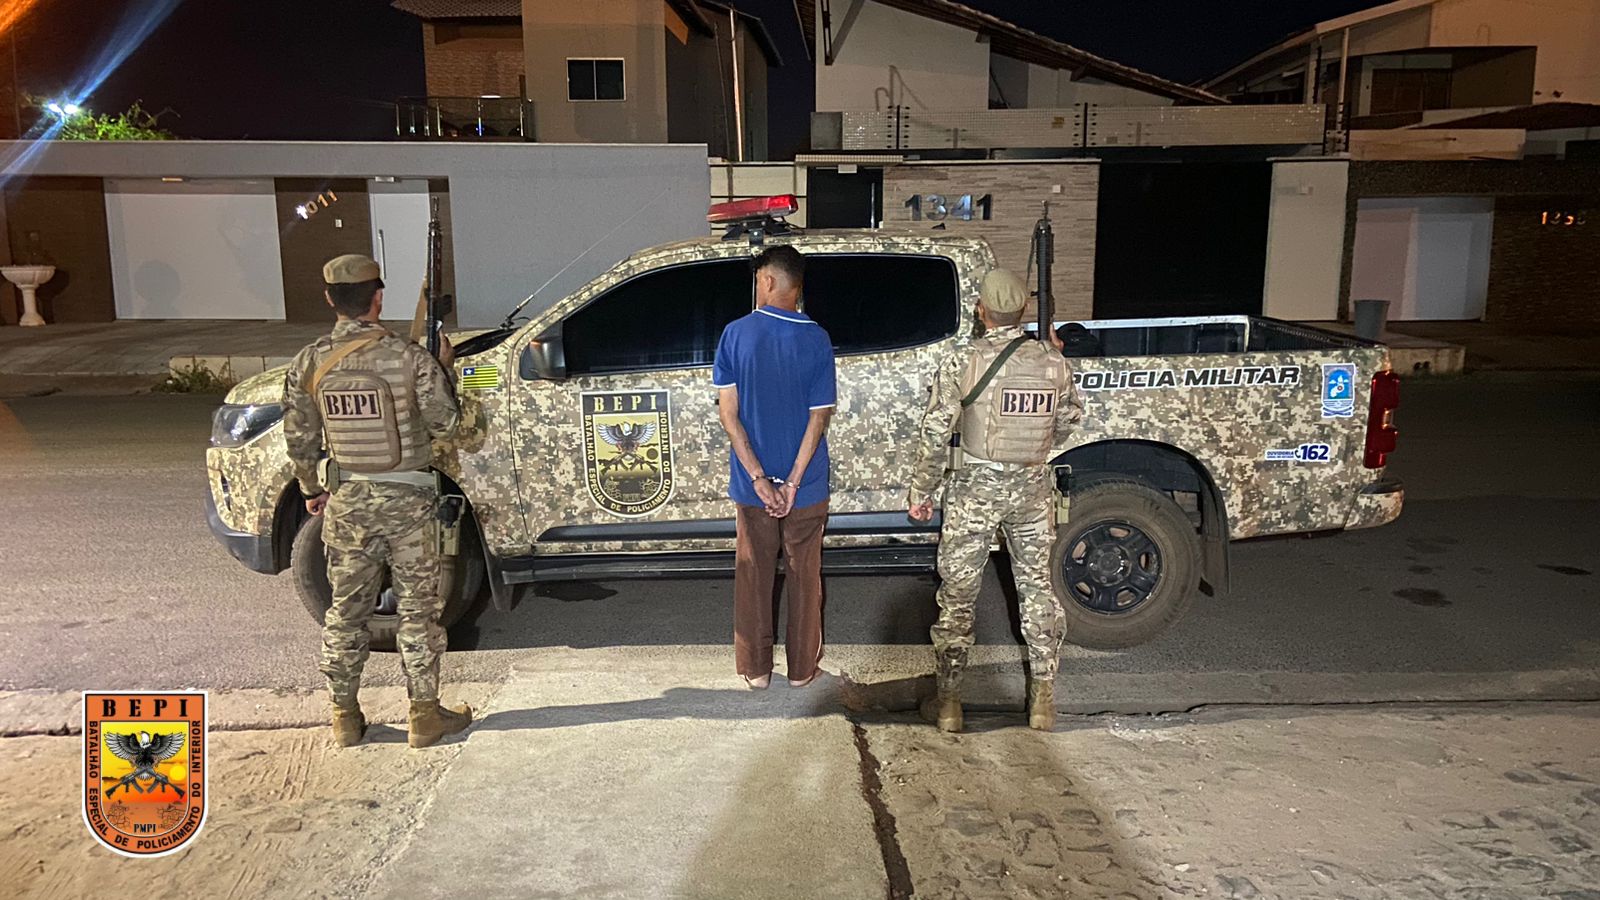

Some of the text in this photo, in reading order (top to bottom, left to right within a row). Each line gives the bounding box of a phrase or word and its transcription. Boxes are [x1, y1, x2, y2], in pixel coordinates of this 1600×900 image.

[904, 193, 992, 221] 1341
[1184, 366, 1300, 386] MILITAR
[325, 394, 378, 415] BEPI
[593, 394, 657, 413] BEPI
[1002, 392, 1053, 413] BEPI
[660, 411, 669, 454] INTERIOR
[1300, 445, 1329, 460] 162
[663, 460, 670, 473] DO
[588, 467, 606, 505] ESPECIAL
[627, 479, 671, 513] POLICIAMENTO
[610, 503, 621, 511] DE
